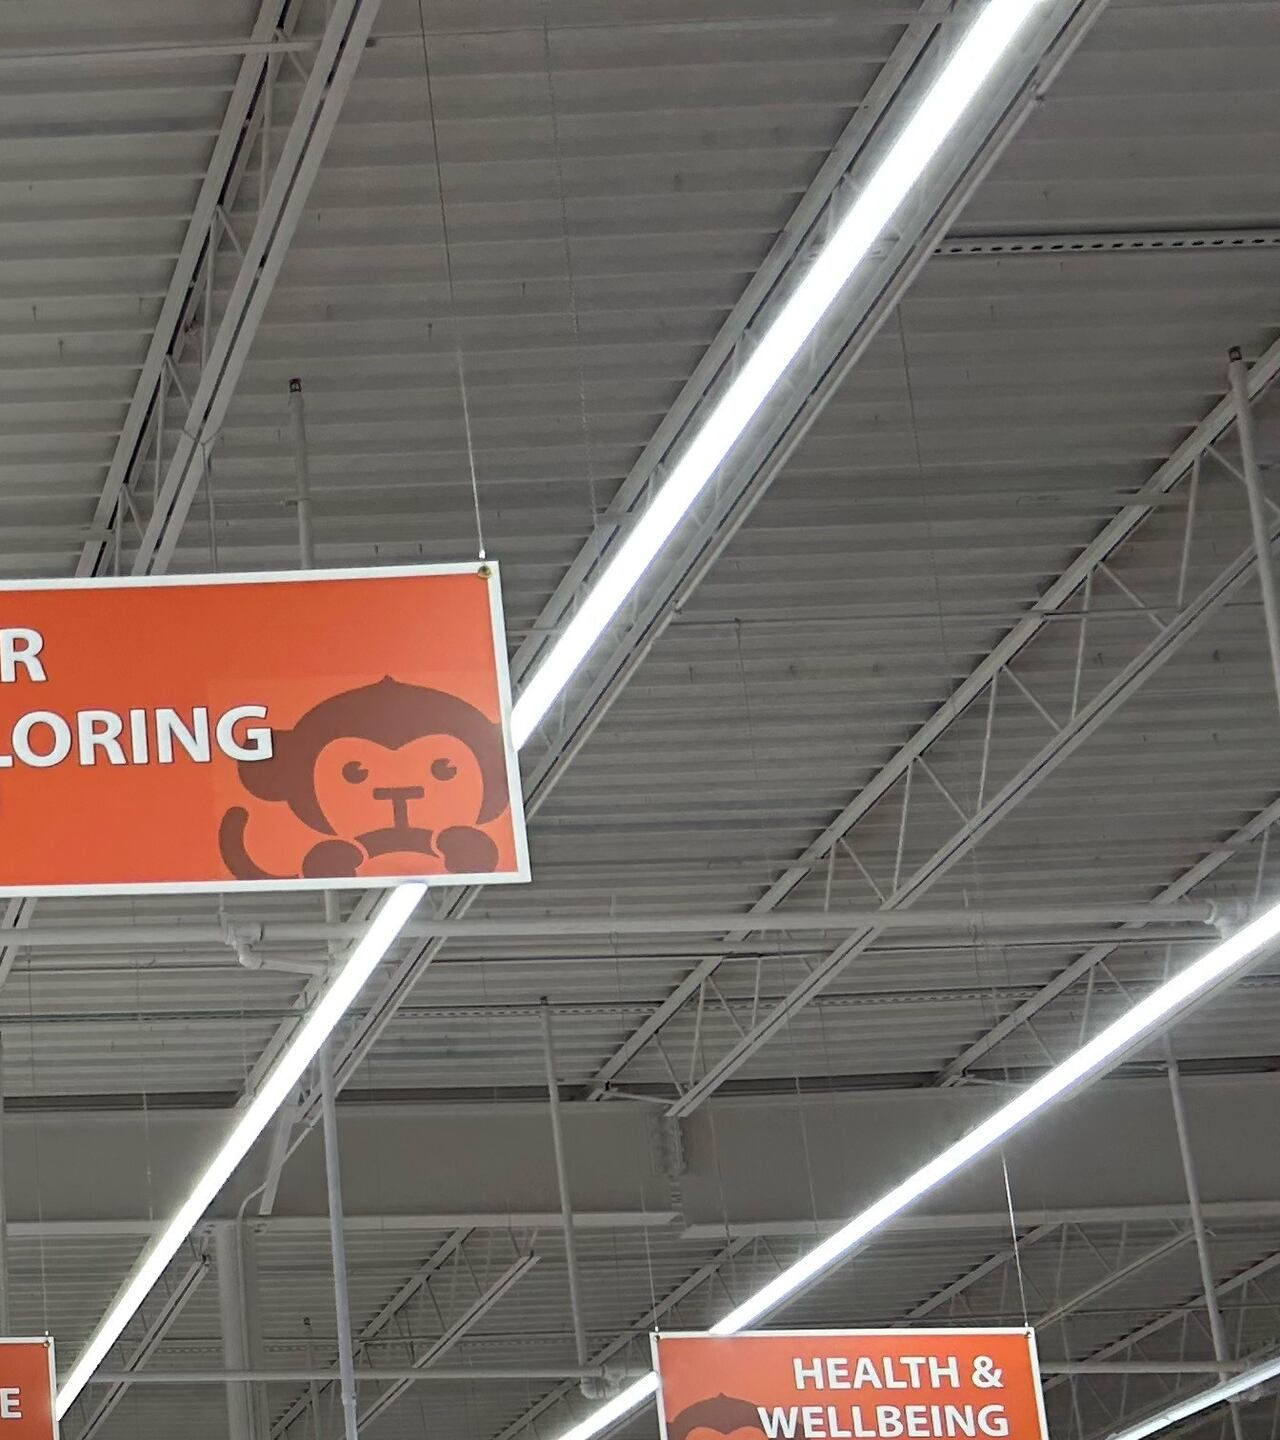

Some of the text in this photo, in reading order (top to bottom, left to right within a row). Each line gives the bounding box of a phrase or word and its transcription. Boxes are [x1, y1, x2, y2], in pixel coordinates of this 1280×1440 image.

[792, 1355, 1003, 1390] HEALTH &
[757, 1404, 1009, 1439] WELLBEING
